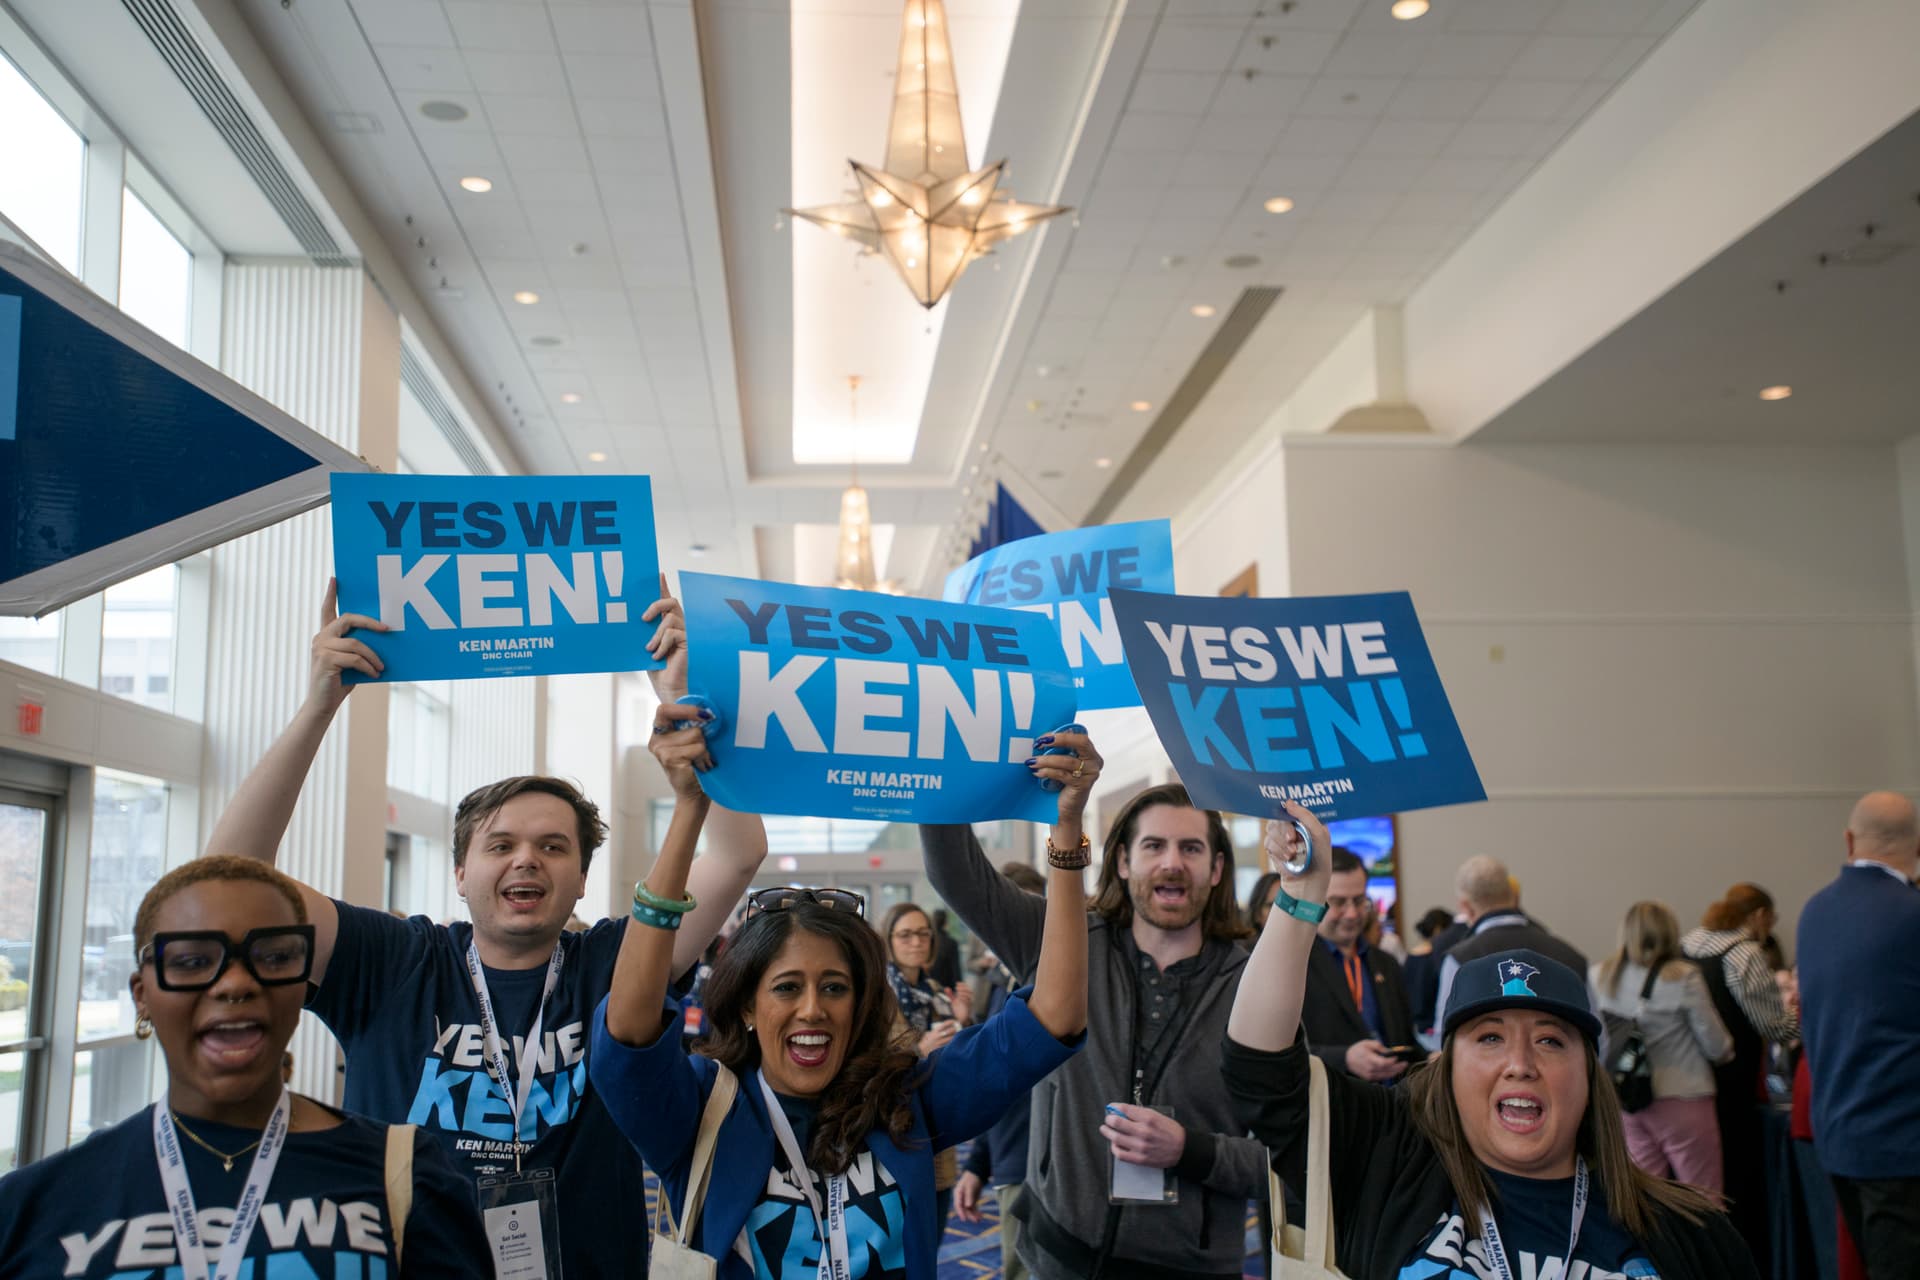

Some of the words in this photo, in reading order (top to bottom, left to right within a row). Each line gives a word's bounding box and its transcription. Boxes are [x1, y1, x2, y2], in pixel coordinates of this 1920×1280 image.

[368, 501, 507, 549] YES
[513, 501, 621, 547] WE
[377, 551, 628, 631] KEN!
[1051, 546, 1142, 596] WE
[459, 639, 491, 653] KEN
[494, 637, 554, 651] MARTIN
[726, 599, 893, 655] YES
[896, 615, 1029, 666] WE
[1144, 620, 1278, 682] YES
[1275, 621, 1398, 680] WE
[482, 652, 502, 660] DNC
[504, 651, 533, 659] CHAIR
[734, 649, 1036, 764] KEN!
[1168, 677, 1428, 773] KEN!
[826, 769, 867, 786] KEN
[870, 771, 942, 790] MARTIN
[853, 788, 878, 797] DNC
[880, 789, 915, 799] CHAIR
[1259, 784, 1287, 799] KEN
[1287, 778, 1355, 800] MARTIN
[1301, 795, 1334, 808] CHAIR
[407, 1057, 586, 1142] KEN!
[258, 1140, 273, 1160] KEN
[456, 1139, 482, 1151] KEN
[830, 1176, 838, 1208] MARTI
[229, 1223, 243, 1244] KEN
[237, 1185, 258, 1222] MARTIN
[830, 1209, 839, 1231] KEN
[60, 1206, 240, 1278] YES
[260, 1198, 388, 1255] WE
[1485, 1222, 1498, 1242] KEN
[1492, 1243, 1510, 1280] MARTIN
[821, 1265, 829, 1280] KE
